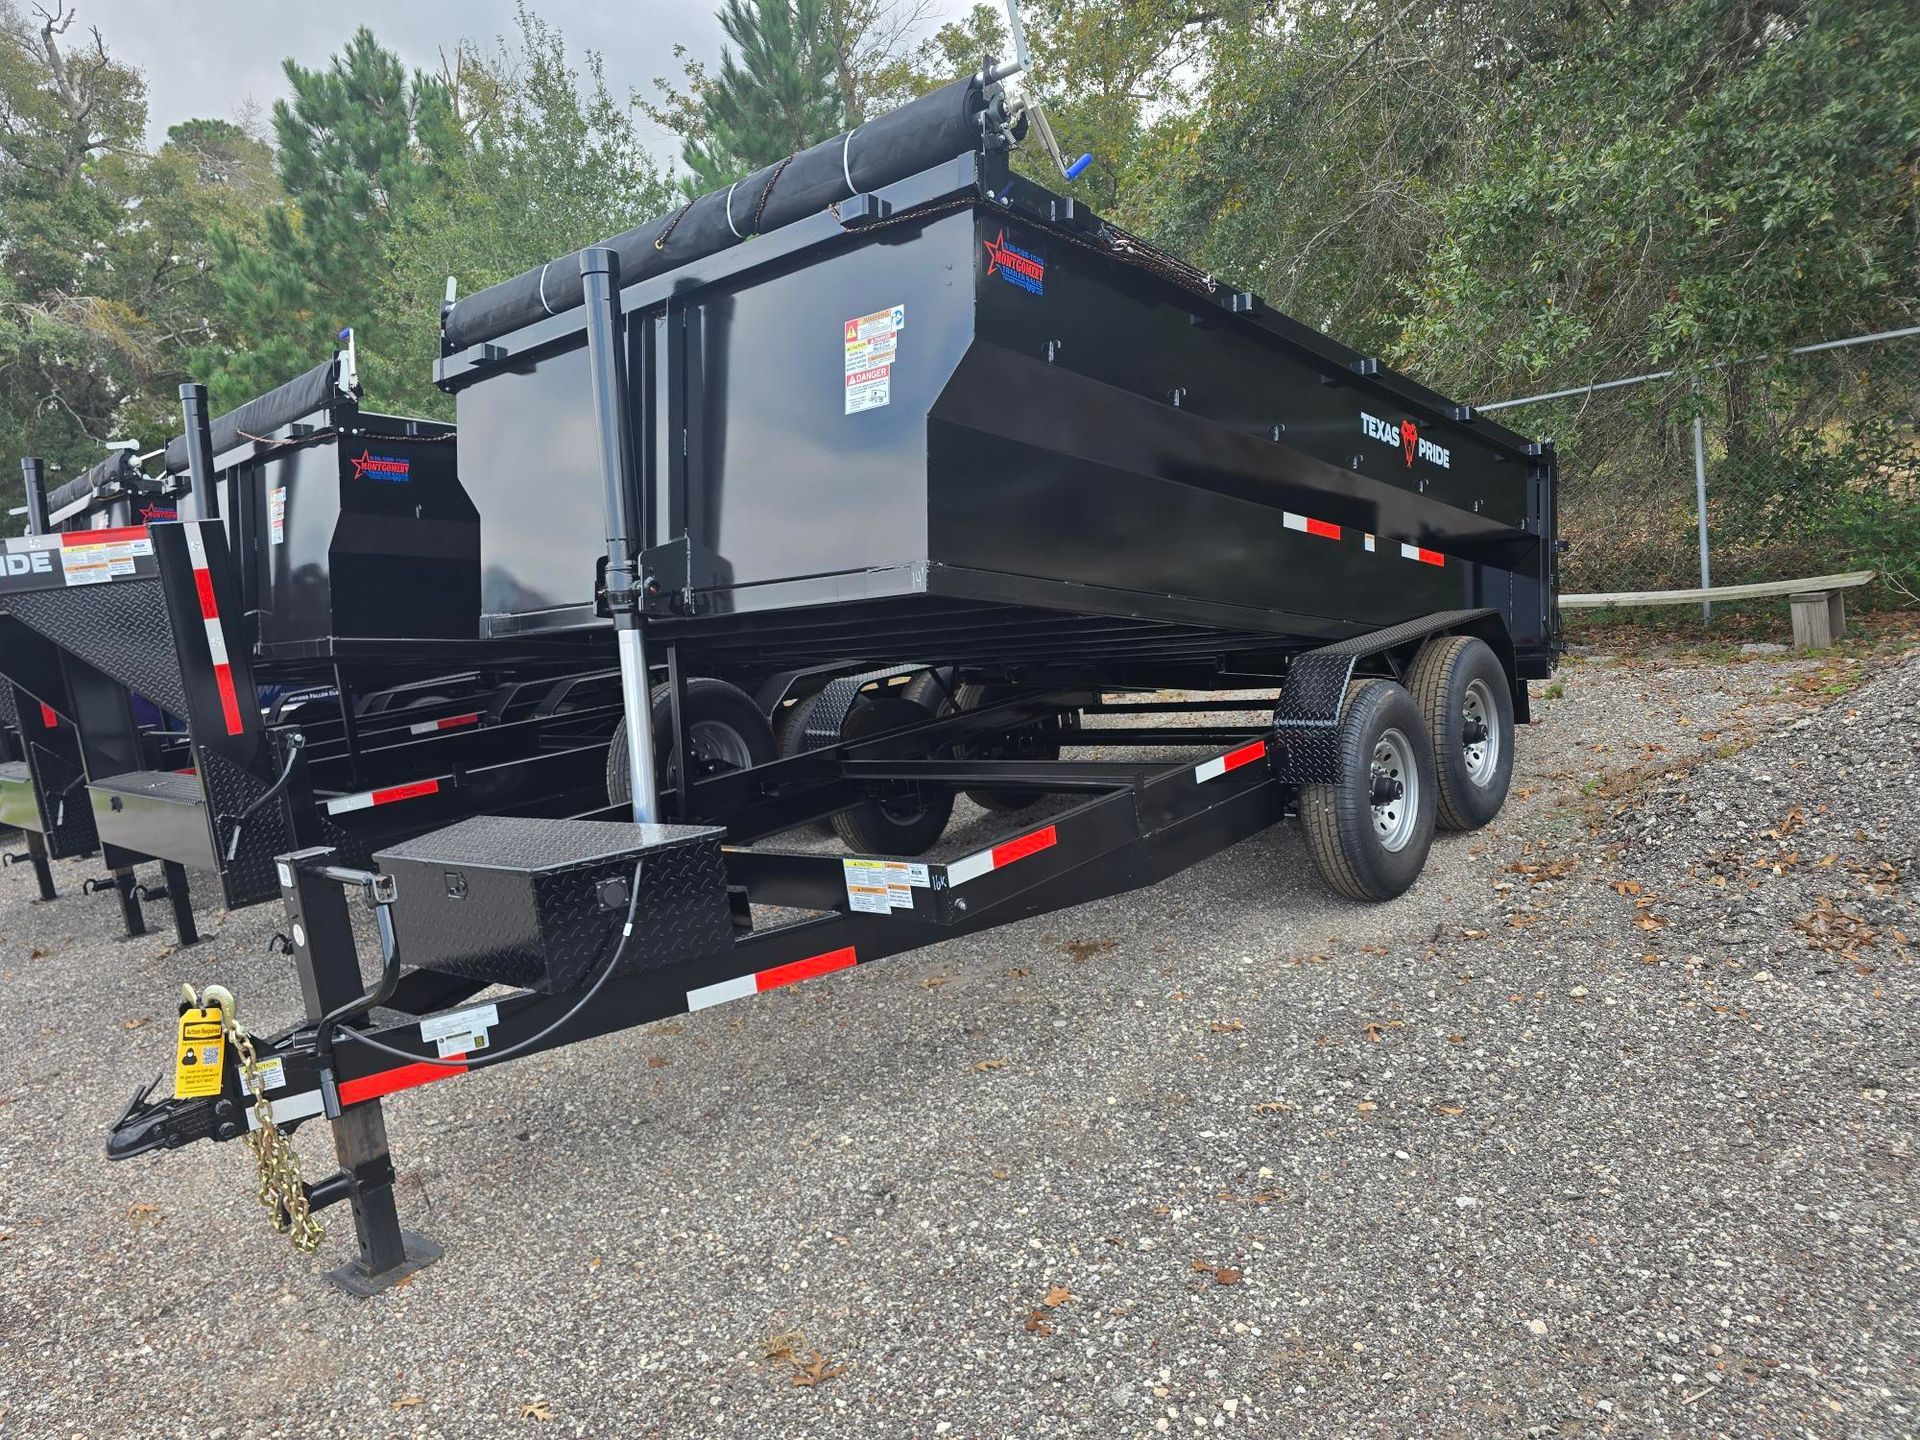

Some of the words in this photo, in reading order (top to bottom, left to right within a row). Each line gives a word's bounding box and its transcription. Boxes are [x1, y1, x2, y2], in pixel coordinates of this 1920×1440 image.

[995, 251, 1044, 281] MONTGOMERY
[857, 367, 887, 382] DANGER
[1360, 411, 1400, 447] TEXAS
[1418, 437, 1450, 469] PRIDE
[361, 462, 409, 474] MONTGOMERY
[258, 1061, 278, 1070] UTION
